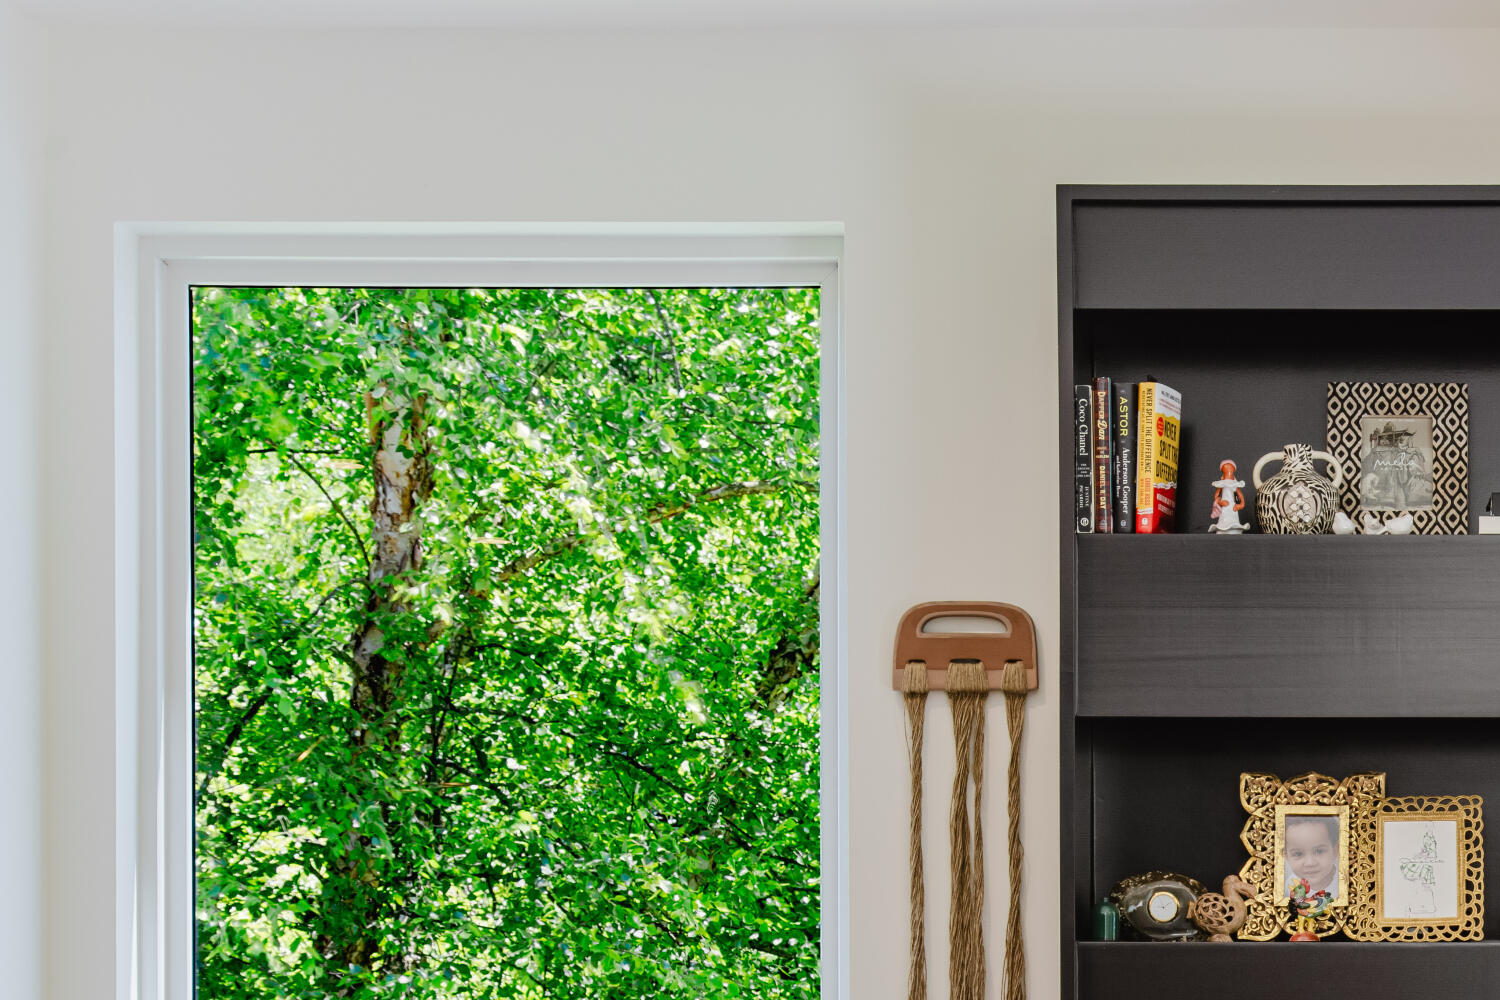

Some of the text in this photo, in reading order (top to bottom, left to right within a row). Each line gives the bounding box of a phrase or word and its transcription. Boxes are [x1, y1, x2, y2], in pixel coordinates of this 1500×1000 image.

[1078, 399, 1089, 422] Coco
[1097, 391, 1107, 419] DAPPER
[1145, 388, 1153, 407] NEVER
[1119, 396, 1129, 436] ASTOR
[1145, 408, 1153, 424] SPLIT
[1078, 424, 1089, 456] Chanel
[1144, 438, 1152, 474] DIFFERENCE
[1120, 447, 1131, 514] Anderson Cooper
